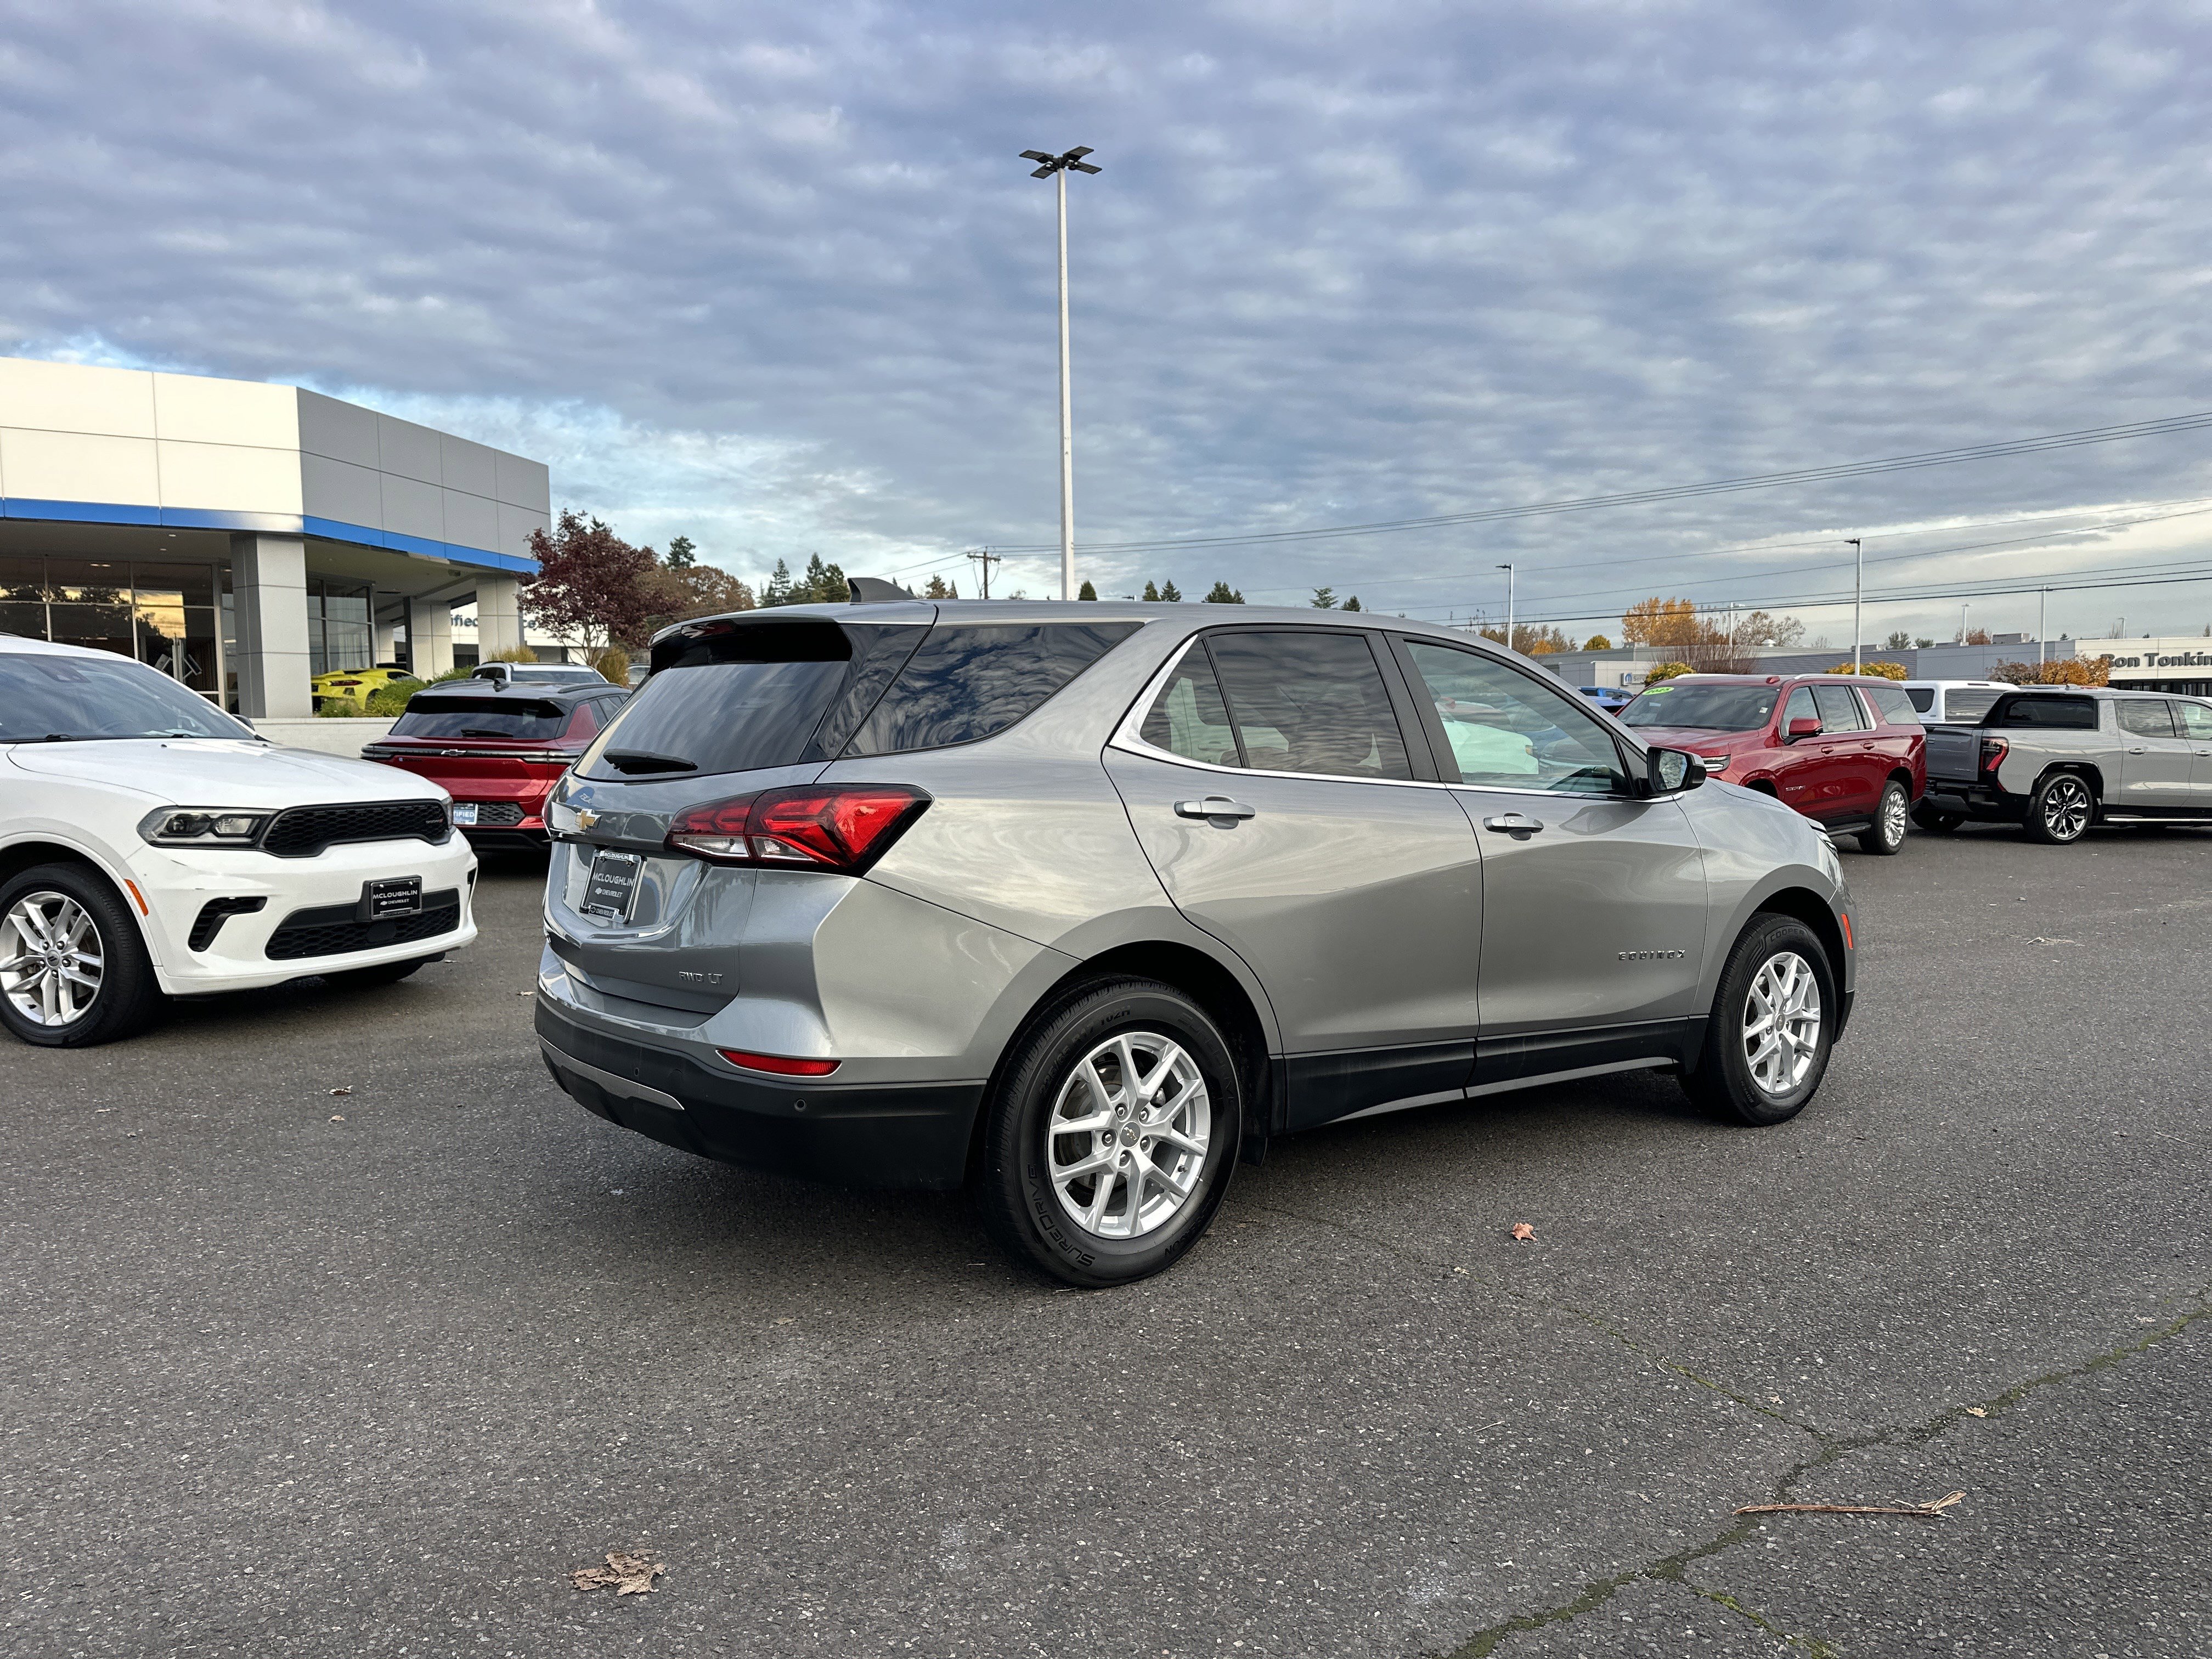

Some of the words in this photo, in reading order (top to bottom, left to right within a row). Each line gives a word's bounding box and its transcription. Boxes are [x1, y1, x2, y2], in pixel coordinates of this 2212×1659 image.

[592, 872, 635, 887] MCLOUGHLIN
[373, 889, 417, 899] MCLOUGHLIN
[602, 889, 623, 898] CHEVROLET
[1770, 928, 1805, 943] COOPER
[1618, 950, 1685, 961] EQUINOX
[679, 971, 703, 983] AWD
[708, 973, 723, 985] LT
[1027, 1163, 1096, 1267] SUREDRIVE
